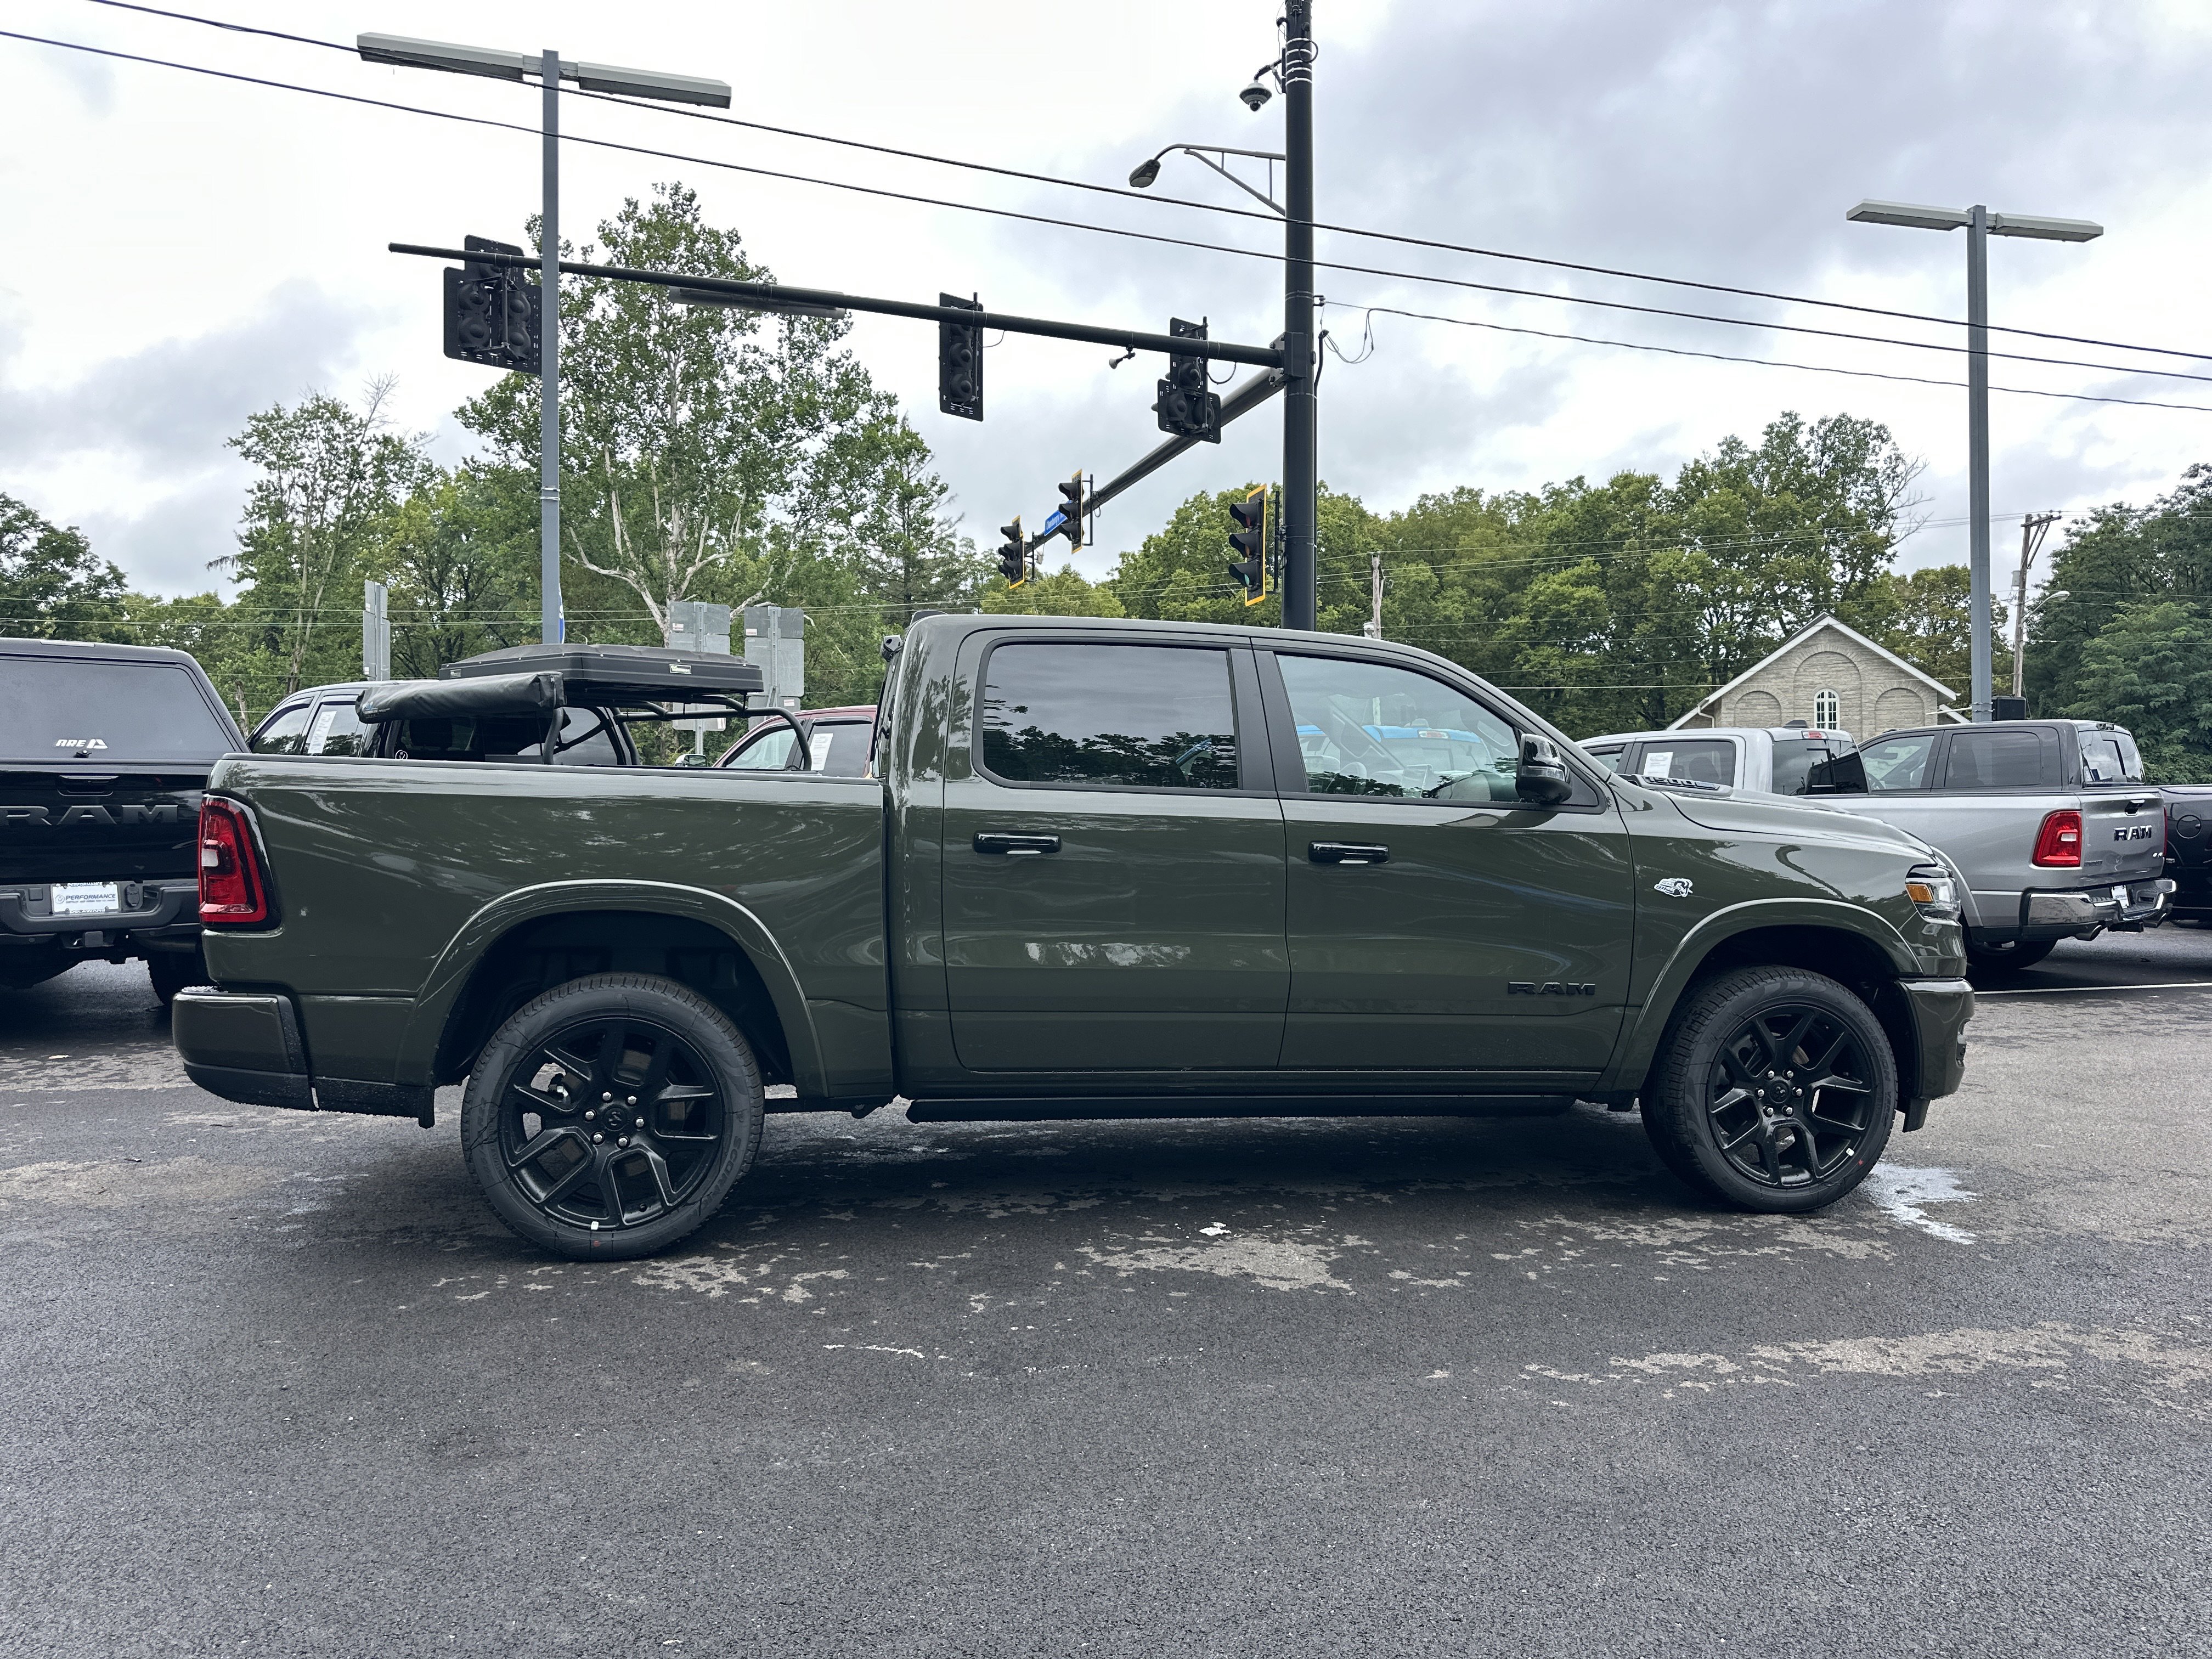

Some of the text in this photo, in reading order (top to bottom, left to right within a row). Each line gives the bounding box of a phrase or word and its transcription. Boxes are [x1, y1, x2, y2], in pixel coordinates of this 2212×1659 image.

[1645, 777, 1695, 787] 1500
[0, 805, 179, 826] RAM
[2114, 825, 2152, 842] RAM
[1508, 981, 1596, 996] RAM
